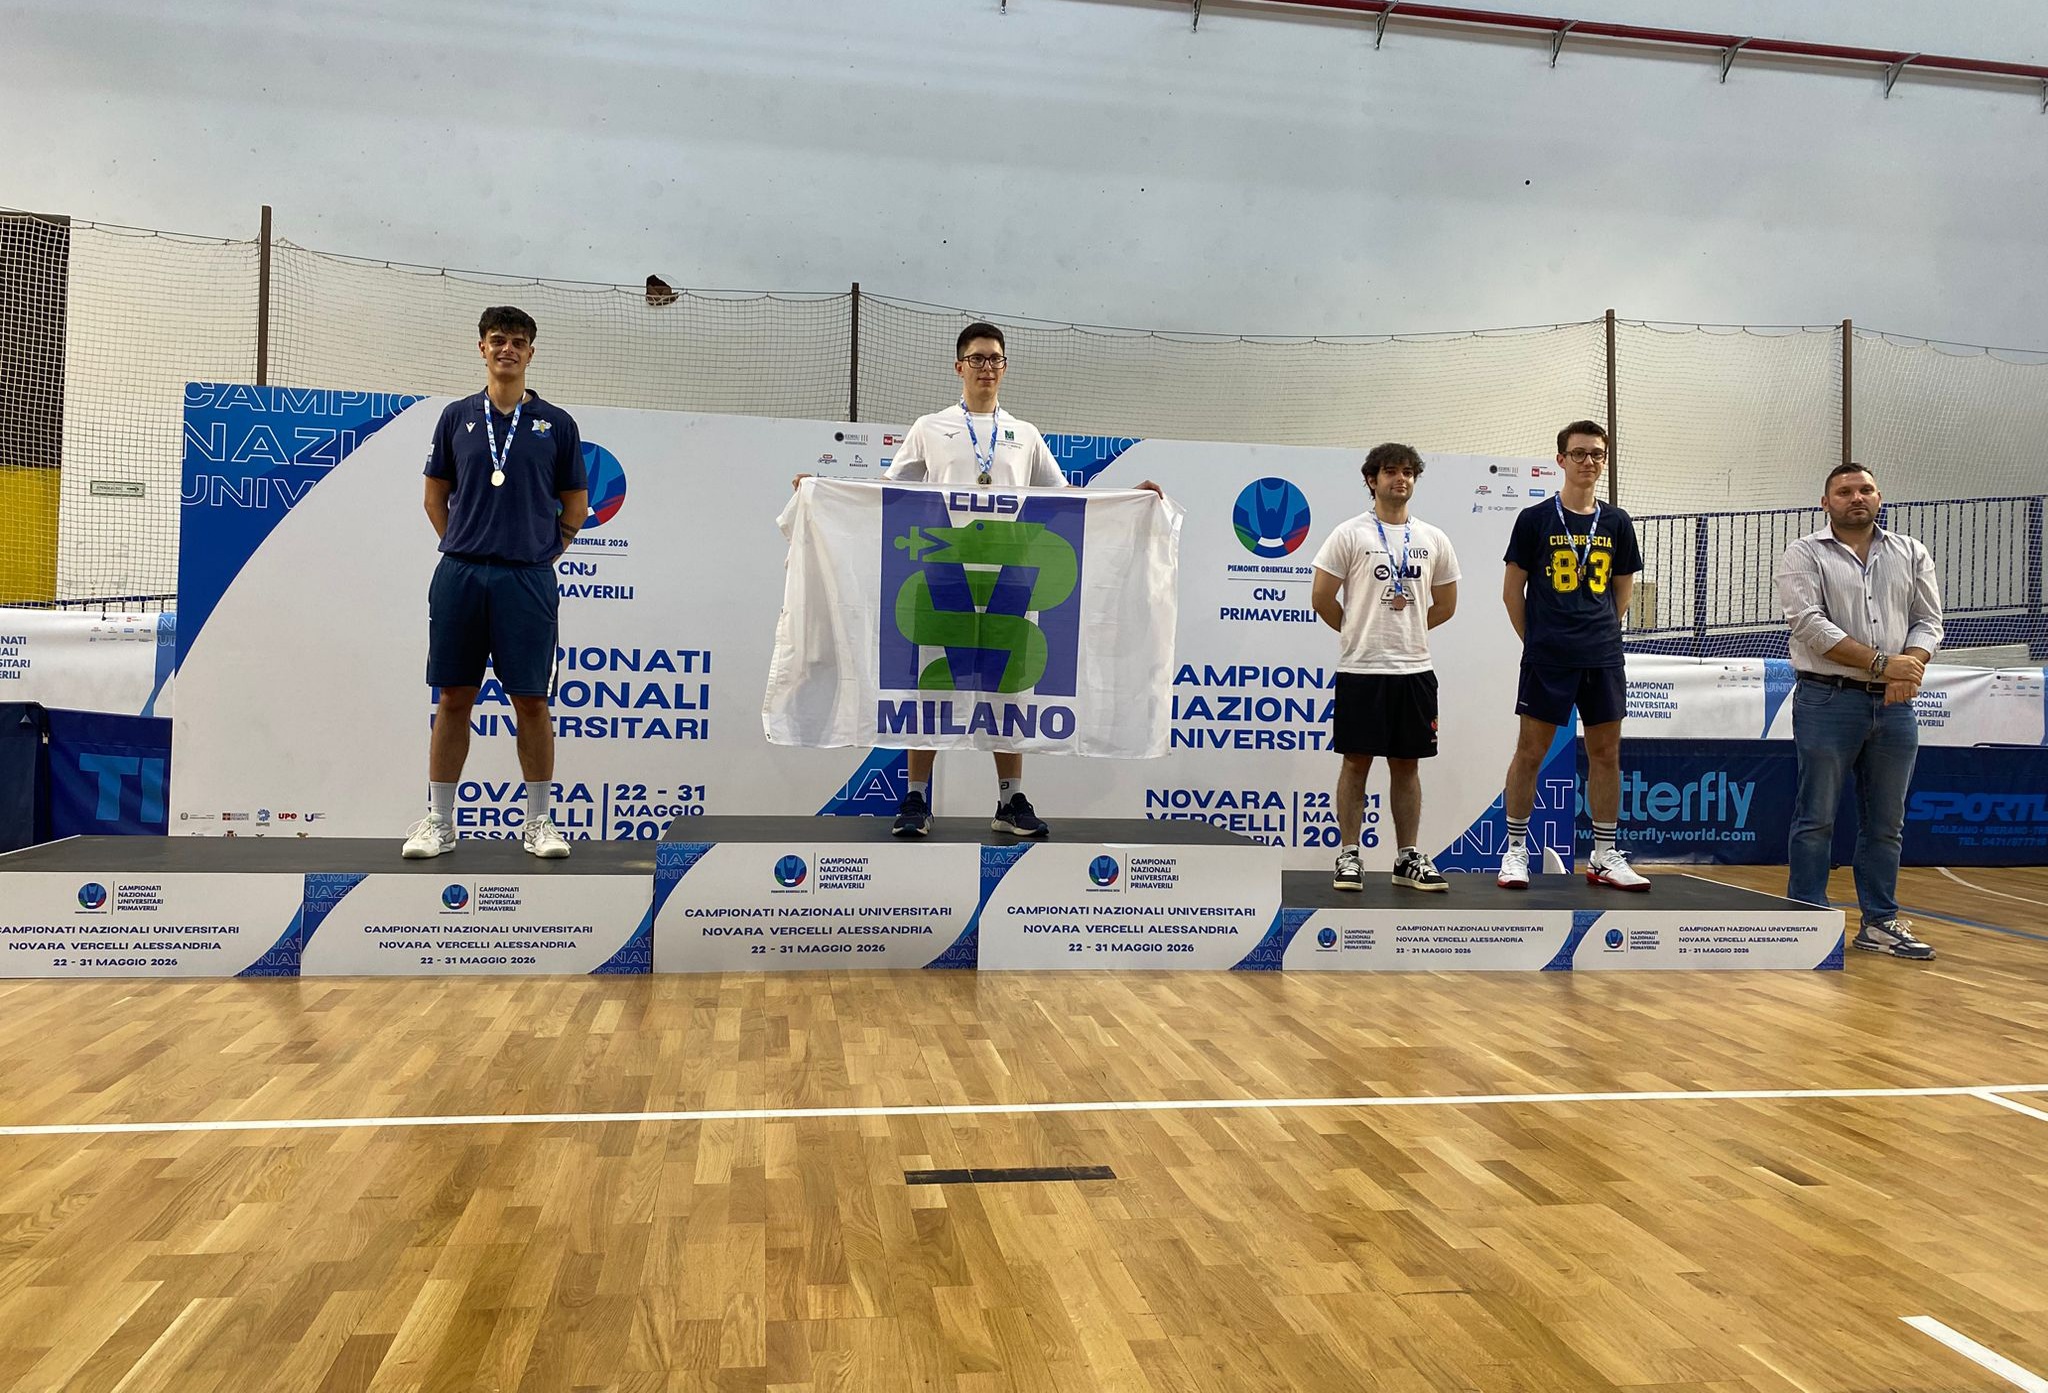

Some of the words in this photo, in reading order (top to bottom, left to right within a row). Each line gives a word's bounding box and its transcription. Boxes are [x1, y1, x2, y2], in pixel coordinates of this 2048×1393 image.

[183, 421, 375, 467] NAZI
[949, 491, 1018, 514] CUS
[608, 539, 629, 547] 2026
[1549, 535, 1569, 546] CUS
[1573, 534, 1612, 548] BRESCIA
[1227, 564, 1260, 573] PIEMONTE
[1260, 565, 1294, 574] ORIENTALE
[1294, 566, 1313, 575] 2026
[1552, 549, 1611, 594] 83
[558, 583, 634, 600] MAVERILI
[1220, 607, 1318, 623] PRIMAVERILI
[0, 647, 19, 656] ALI
[1172, 664, 1337, 690] AMPION
[1913, 709, 1951, 718] VERSITARI
[877, 699, 1076, 740] MILANO
[1917, 719, 1945, 727] AVERILI
[1170, 728, 1335, 751] NIVERSIT
[615, 784, 647, 801] 22
[677, 784, 706, 802] 31
[1146, 789, 1286, 810] NOVARA
[1303, 792, 1330, 808] 22
[614, 804, 705, 818] MAGGIO
[1931, 825, 1978, 834] BOLZANO
[1303, 826, 1380, 848] 206
[820, 857, 869, 865] CAMPIONATI
[1130, 858, 1177, 866] CAMPIONATI
[684, 908, 774, 918] CAMPIONATI
[778, 907, 855, 917] NAZIONALI
[858, 907, 952, 917] UNIVERSITARI
[1007, 906, 1090, 915] CAMPIONATI
[1093, 906, 1164, 916] NAZIONALI
[1167, 907, 1256, 917] UNIVERSITARI
[0, 926, 76, 934] AMPIONATI
[79, 926, 149, 934] NAZIONALI
[153, 926, 240, 934] UNIVERSITARI
[363, 925, 440, 934] CAMPIONATI
[444, 925, 509, 934] NAZIONALI
[512, 925, 593, 934] UNIVERSITARI
[702, 926, 764, 936] NOVARA
[769, 926, 833, 936] VERCELLI
[836, 926, 933, 935] ALESSANDRIA
[1023, 925, 1080, 934] NOVARA
[1085, 925, 1144, 934] VERCELLI
[1148, 925, 1239, 935] ALESSANDRIA
[9, 942, 66, 950] NOVARA
[71, 942, 129, 950] VERCELLI
[133, 942, 222, 950] ALESSANDRIA
[379, 941, 432, 949] NOVARA
[436, 941, 490, 949] VERCELLI
[493, 941, 577, 949] ALESSANDRIA
[750, 945, 766, 954] 22
[779, 945, 794, 954] 31
[797, 945, 852, 953] MAGGIO
[856, 944, 886, 953] 2026
[1068, 944, 1083, 952] 22
[1095, 944, 1108, 952] 31
[1111, 944, 1163, 952] MAGGIO
[1166, 944, 1194, 952] 2026
[53, 958, 67, 967] 22
[79, 958, 93, 967] 31
[96, 958, 147, 967] MAGGIO
[150, 958, 178, 967] 2026
